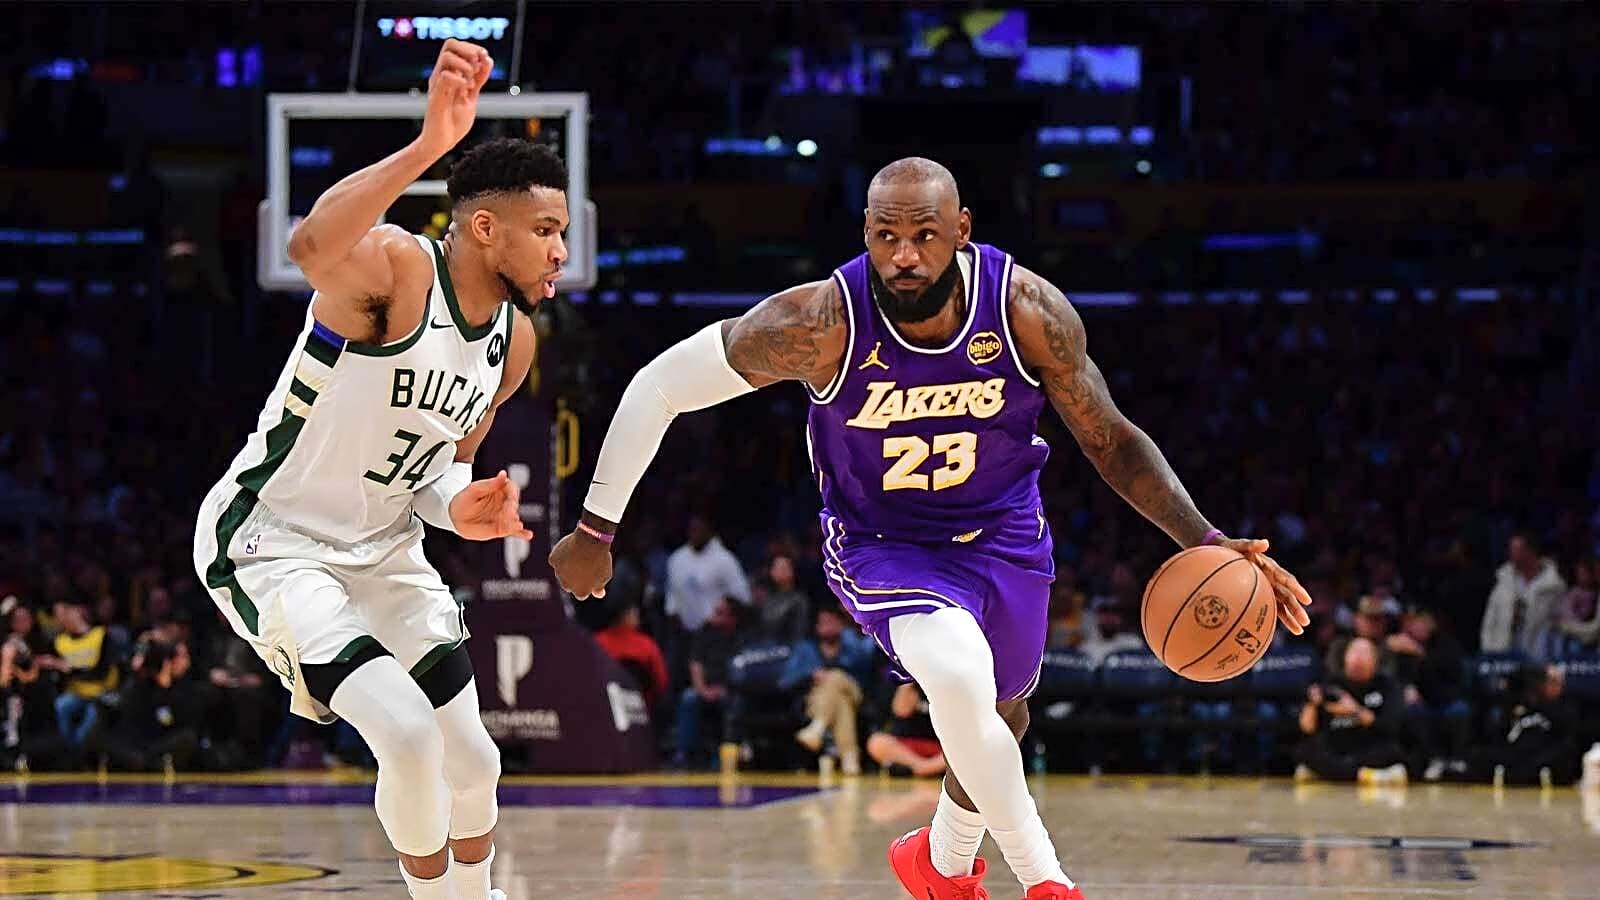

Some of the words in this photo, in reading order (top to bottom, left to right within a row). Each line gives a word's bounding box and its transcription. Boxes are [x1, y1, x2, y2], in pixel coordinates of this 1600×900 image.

[412, 17, 509, 40] TISSOT
[970, 340, 1000, 354] bibigo
[846, 378, 1006, 430] LAKERS
[363, 429, 449, 490] 34
[883, 431, 978, 492] 23
